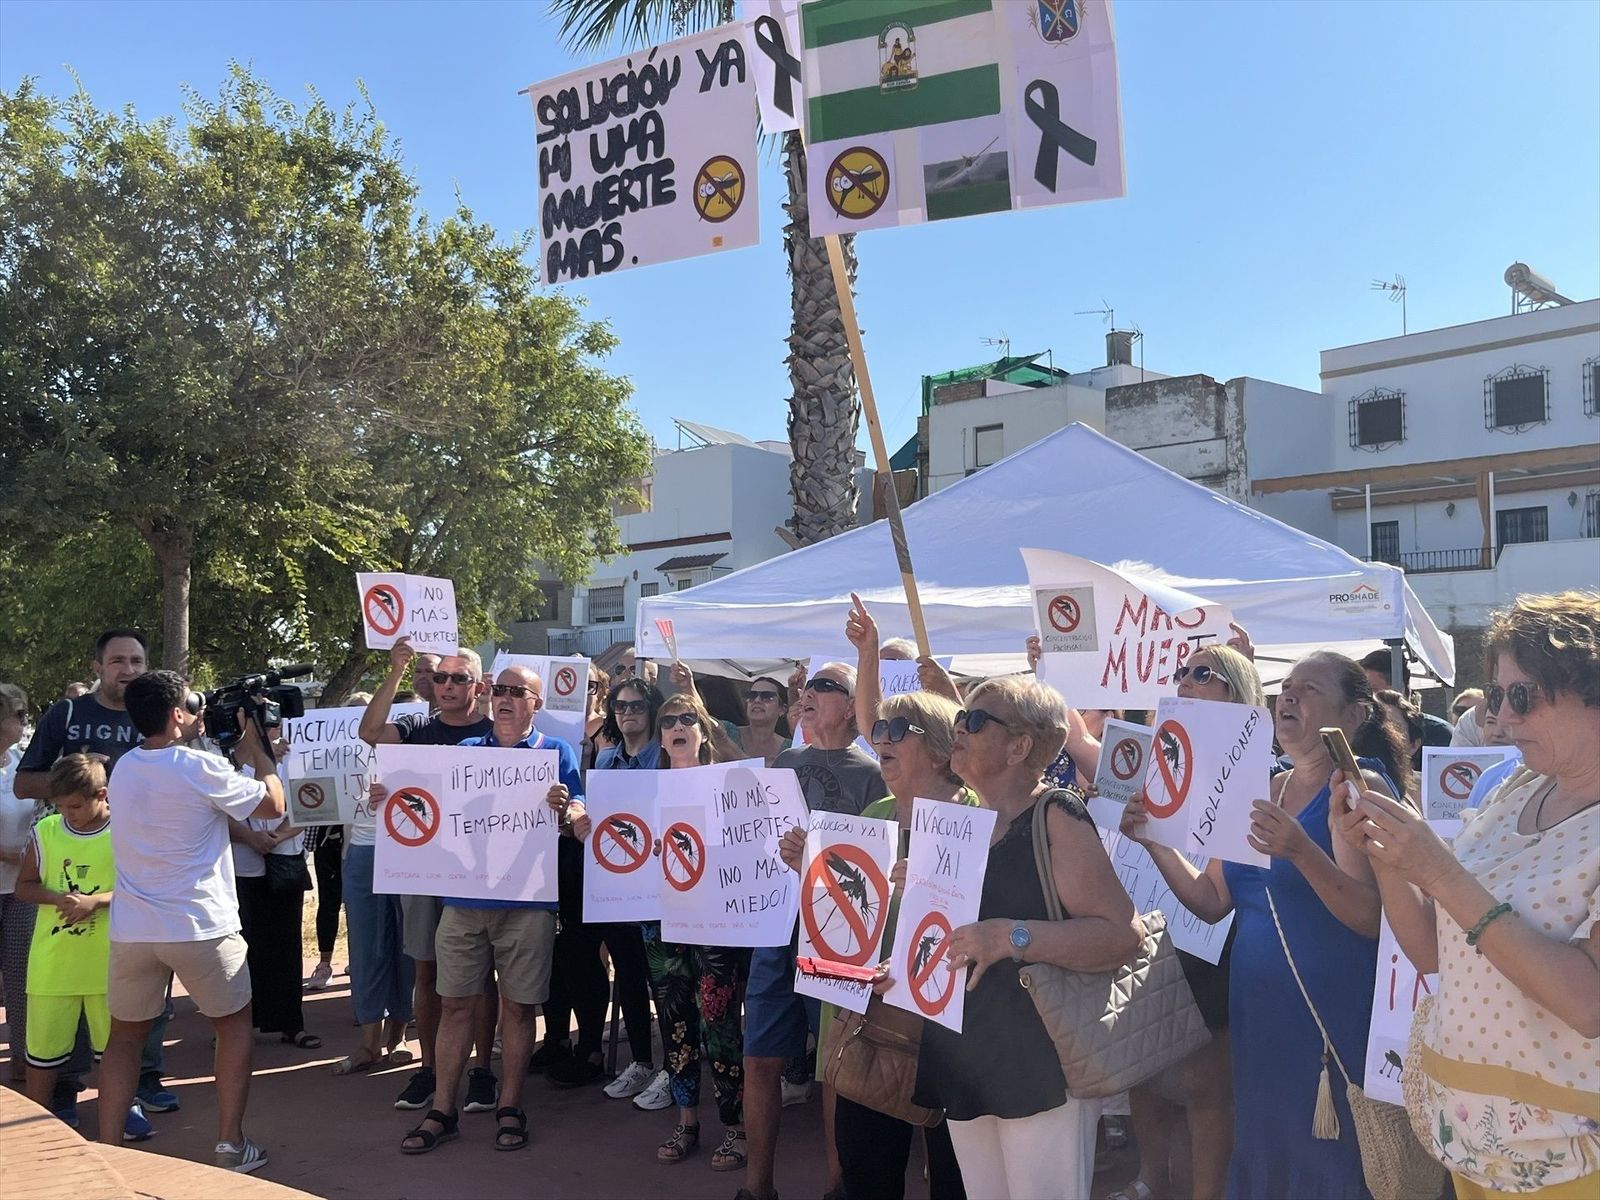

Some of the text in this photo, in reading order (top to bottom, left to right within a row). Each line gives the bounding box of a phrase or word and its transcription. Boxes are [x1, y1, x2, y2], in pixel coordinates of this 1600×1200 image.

[695, 38, 746, 93] YA
[542, 158, 677, 239] MUERTE
[746, 781, 781, 808] MÁS
